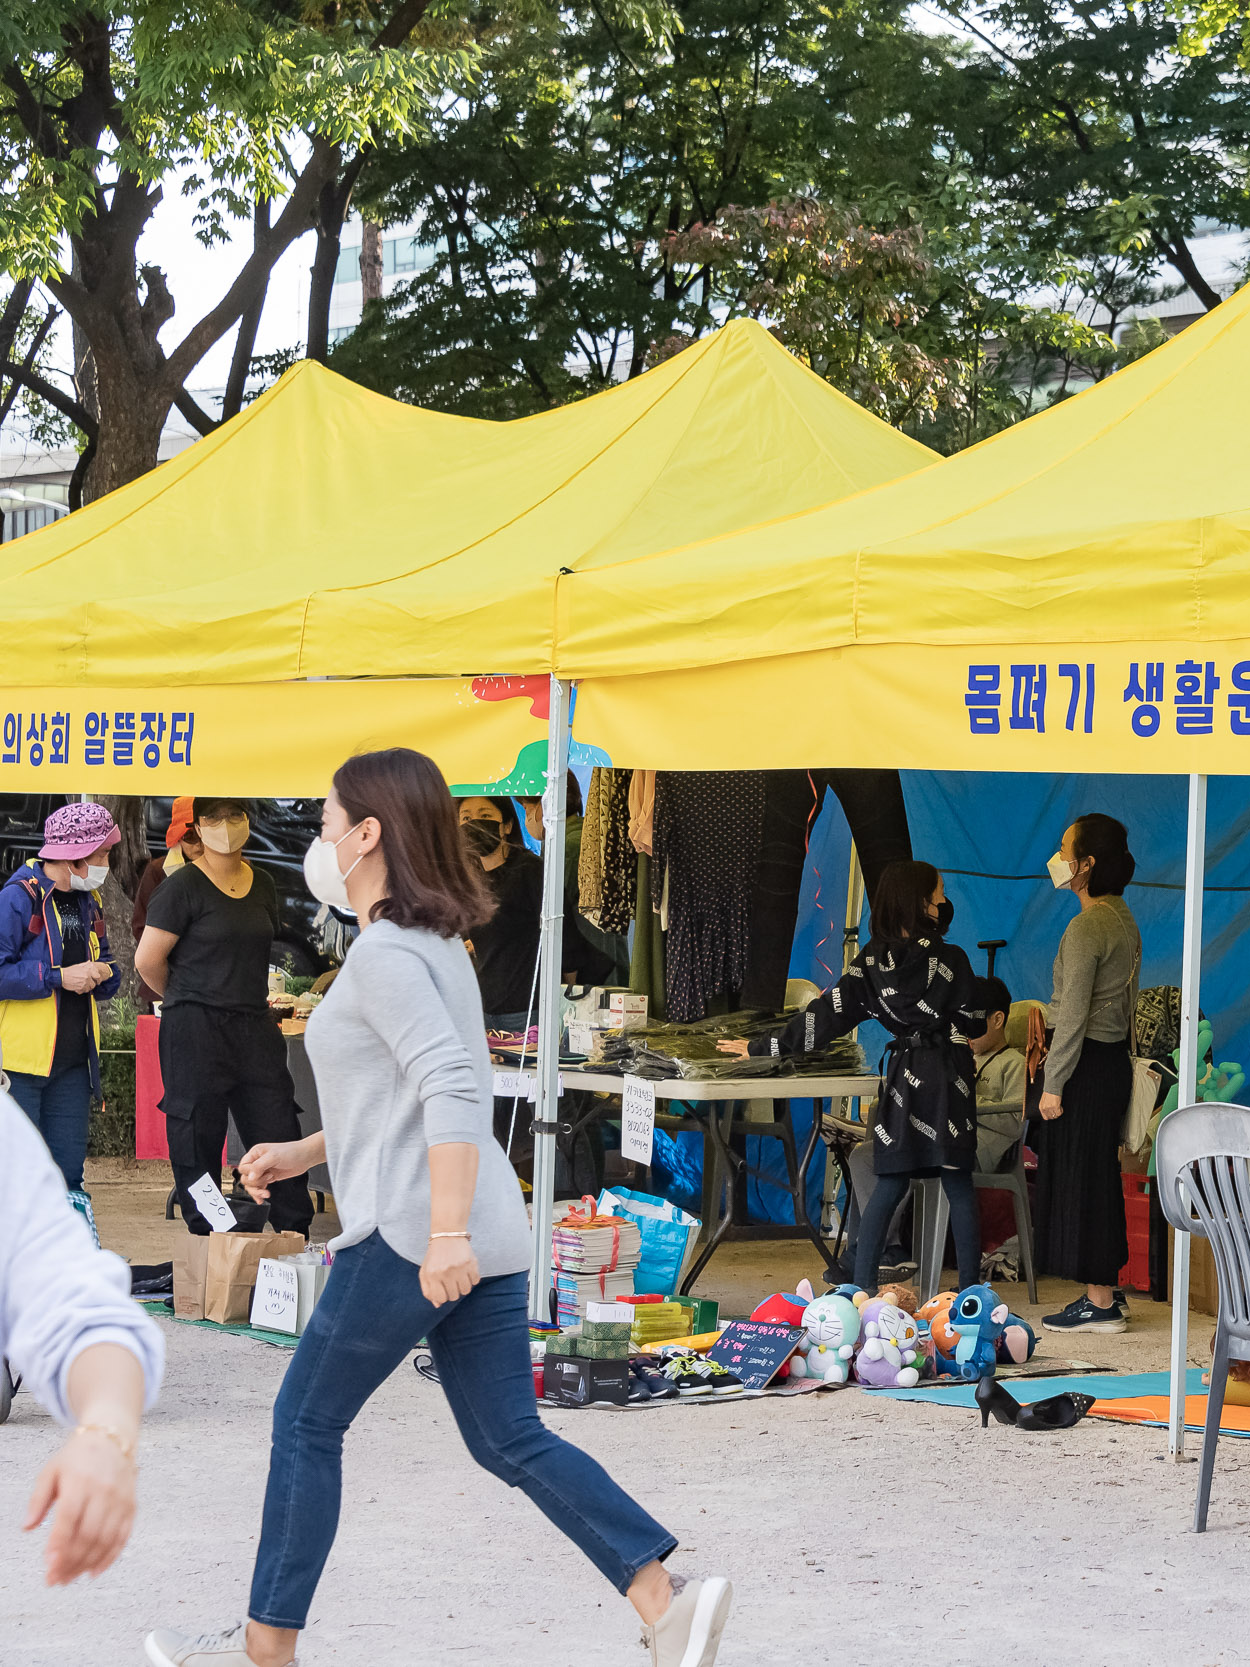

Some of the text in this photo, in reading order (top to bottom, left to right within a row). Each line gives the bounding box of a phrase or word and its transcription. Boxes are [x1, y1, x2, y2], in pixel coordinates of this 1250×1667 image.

[963, 663, 1095, 735] 몸펴기
[1, 711, 195, 769] 의상회 알뜰장터
